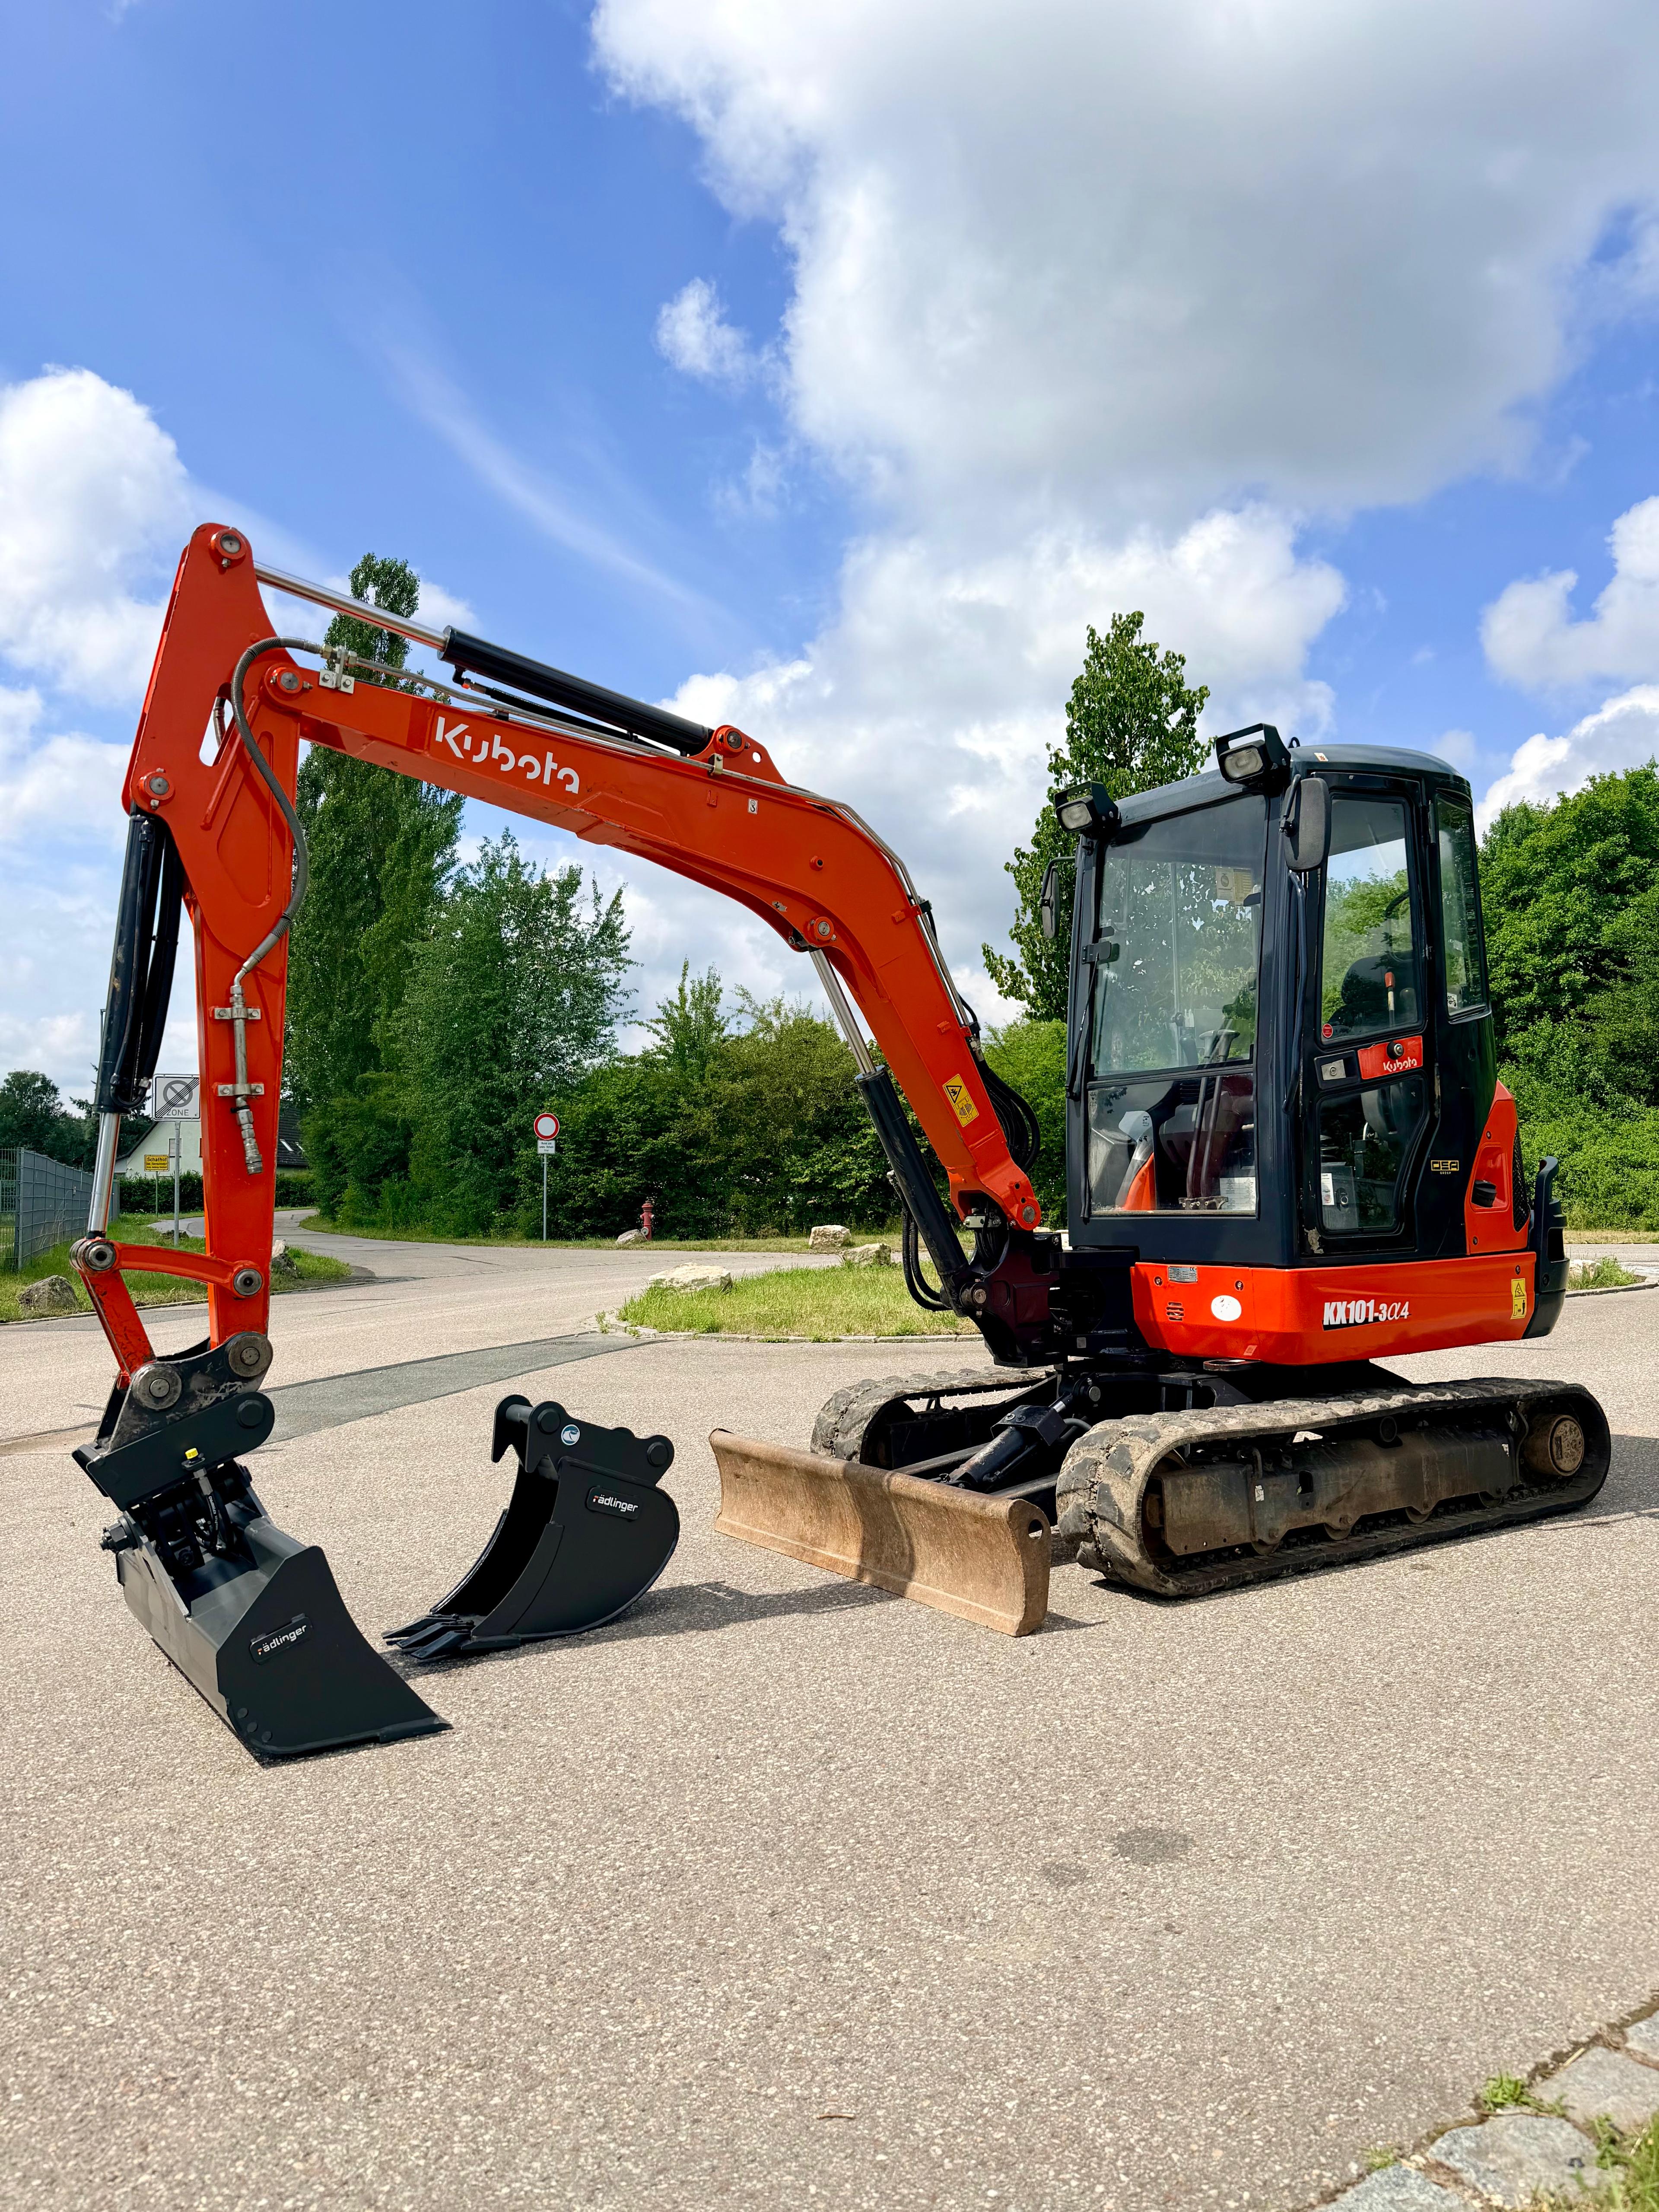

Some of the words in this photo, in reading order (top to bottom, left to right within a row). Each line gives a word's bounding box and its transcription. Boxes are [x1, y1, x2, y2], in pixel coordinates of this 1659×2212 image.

[435, 716, 580, 794] Kubota
[1383, 1057, 1417, 1072] Kubota
[593, 1494, 638, 1512] rädlinger
[257, 1625, 307, 1655] rädlinger
